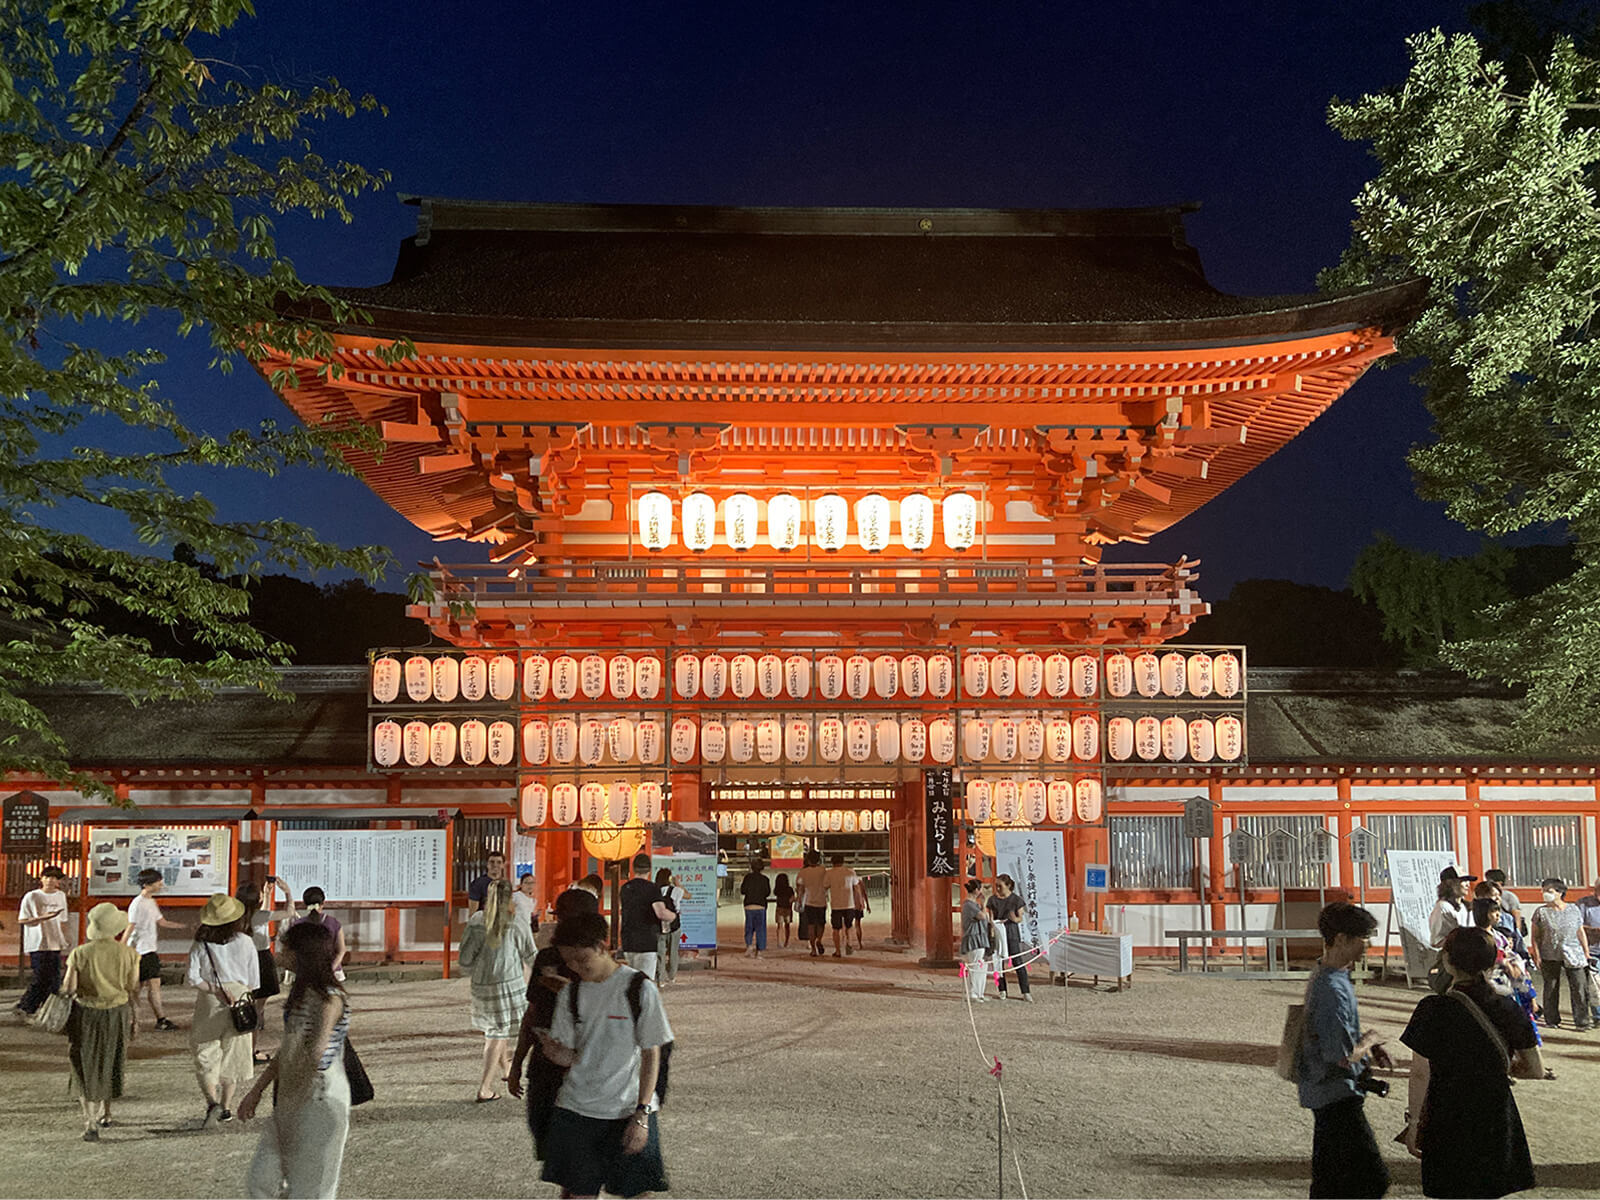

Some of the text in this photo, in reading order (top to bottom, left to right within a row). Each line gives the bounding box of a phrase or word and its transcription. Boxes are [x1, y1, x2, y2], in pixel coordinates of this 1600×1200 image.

[931, 801, 954, 874] みたらし祭
